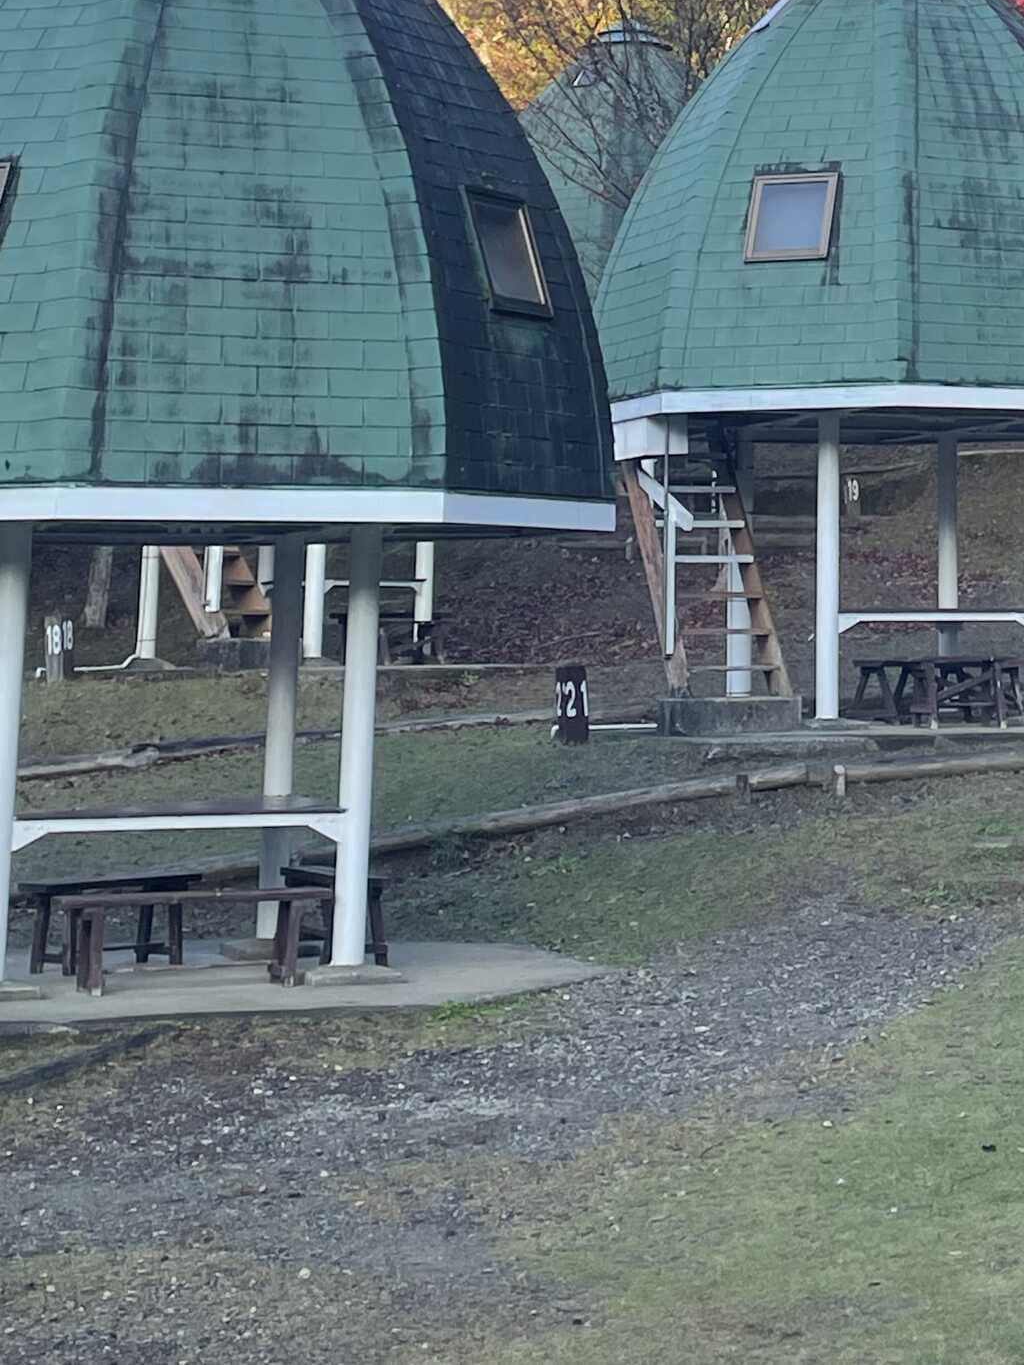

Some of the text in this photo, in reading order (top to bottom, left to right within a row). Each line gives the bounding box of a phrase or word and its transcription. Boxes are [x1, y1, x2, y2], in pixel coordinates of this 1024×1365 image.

[848, 480, 859, 501] 19
[47, 625, 61, 655] 18
[63, 620, 73, 650] 18
